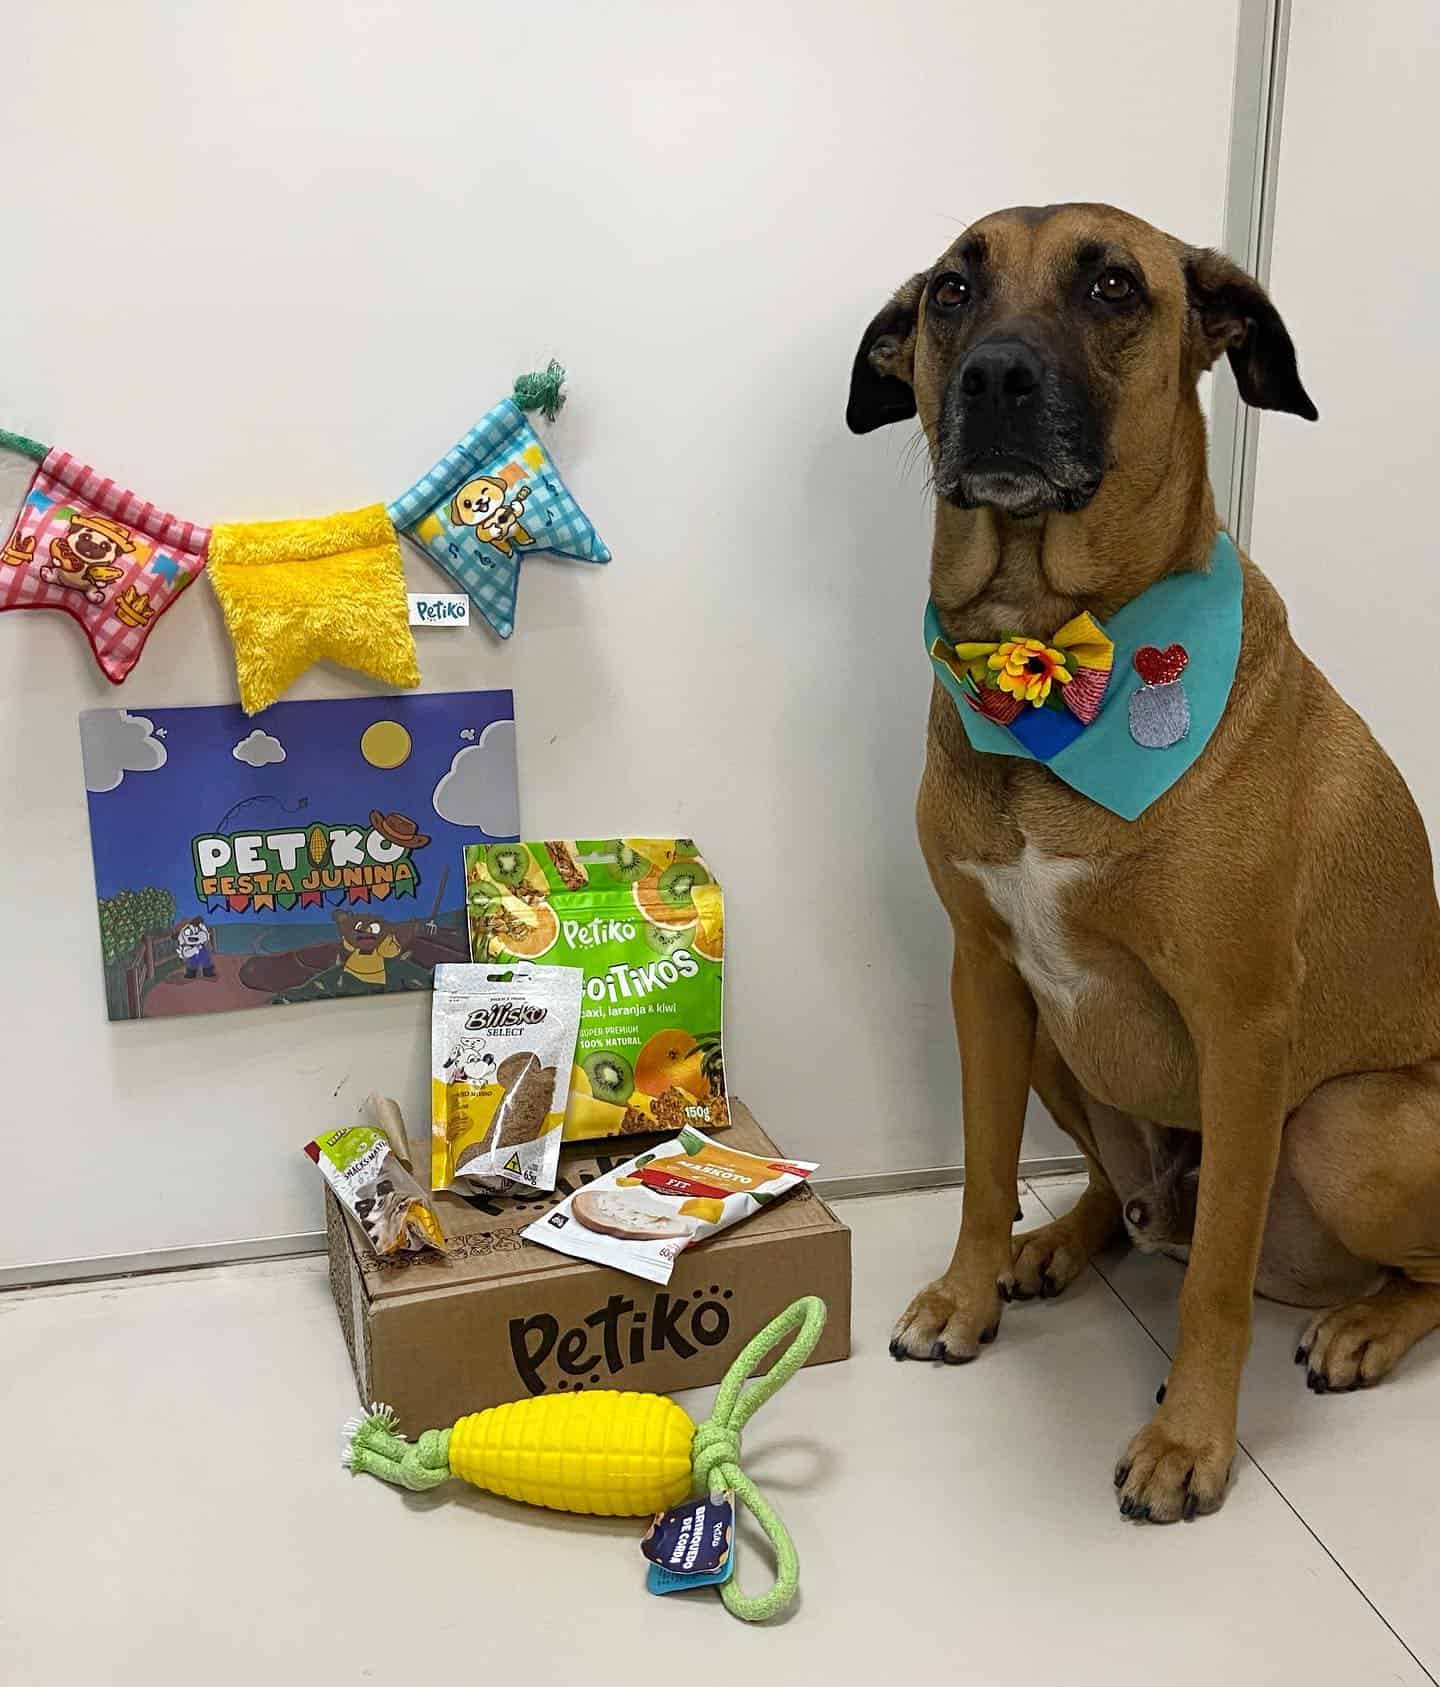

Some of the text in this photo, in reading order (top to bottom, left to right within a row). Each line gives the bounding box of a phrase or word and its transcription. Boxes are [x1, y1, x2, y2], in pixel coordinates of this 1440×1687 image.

[202, 863, 413, 896] FESTA JUNINA
[608, 1003, 646, 1018] laranja
[656, 1002, 677, 1014] kiwi
[486, 1027, 525, 1037] SELECT
[605, 1025, 639, 1036] PREMIUM
[580, 1036, 641, 1049] 100% NATURAL
[685, 1105, 711, 1122] 150g
[523, 1169, 537, 1186] 65g
[665, 1178, 692, 1190] FIT
[681, 1516, 693, 1534] DE
[683, 1505, 706, 1570] BRINQUEDO
